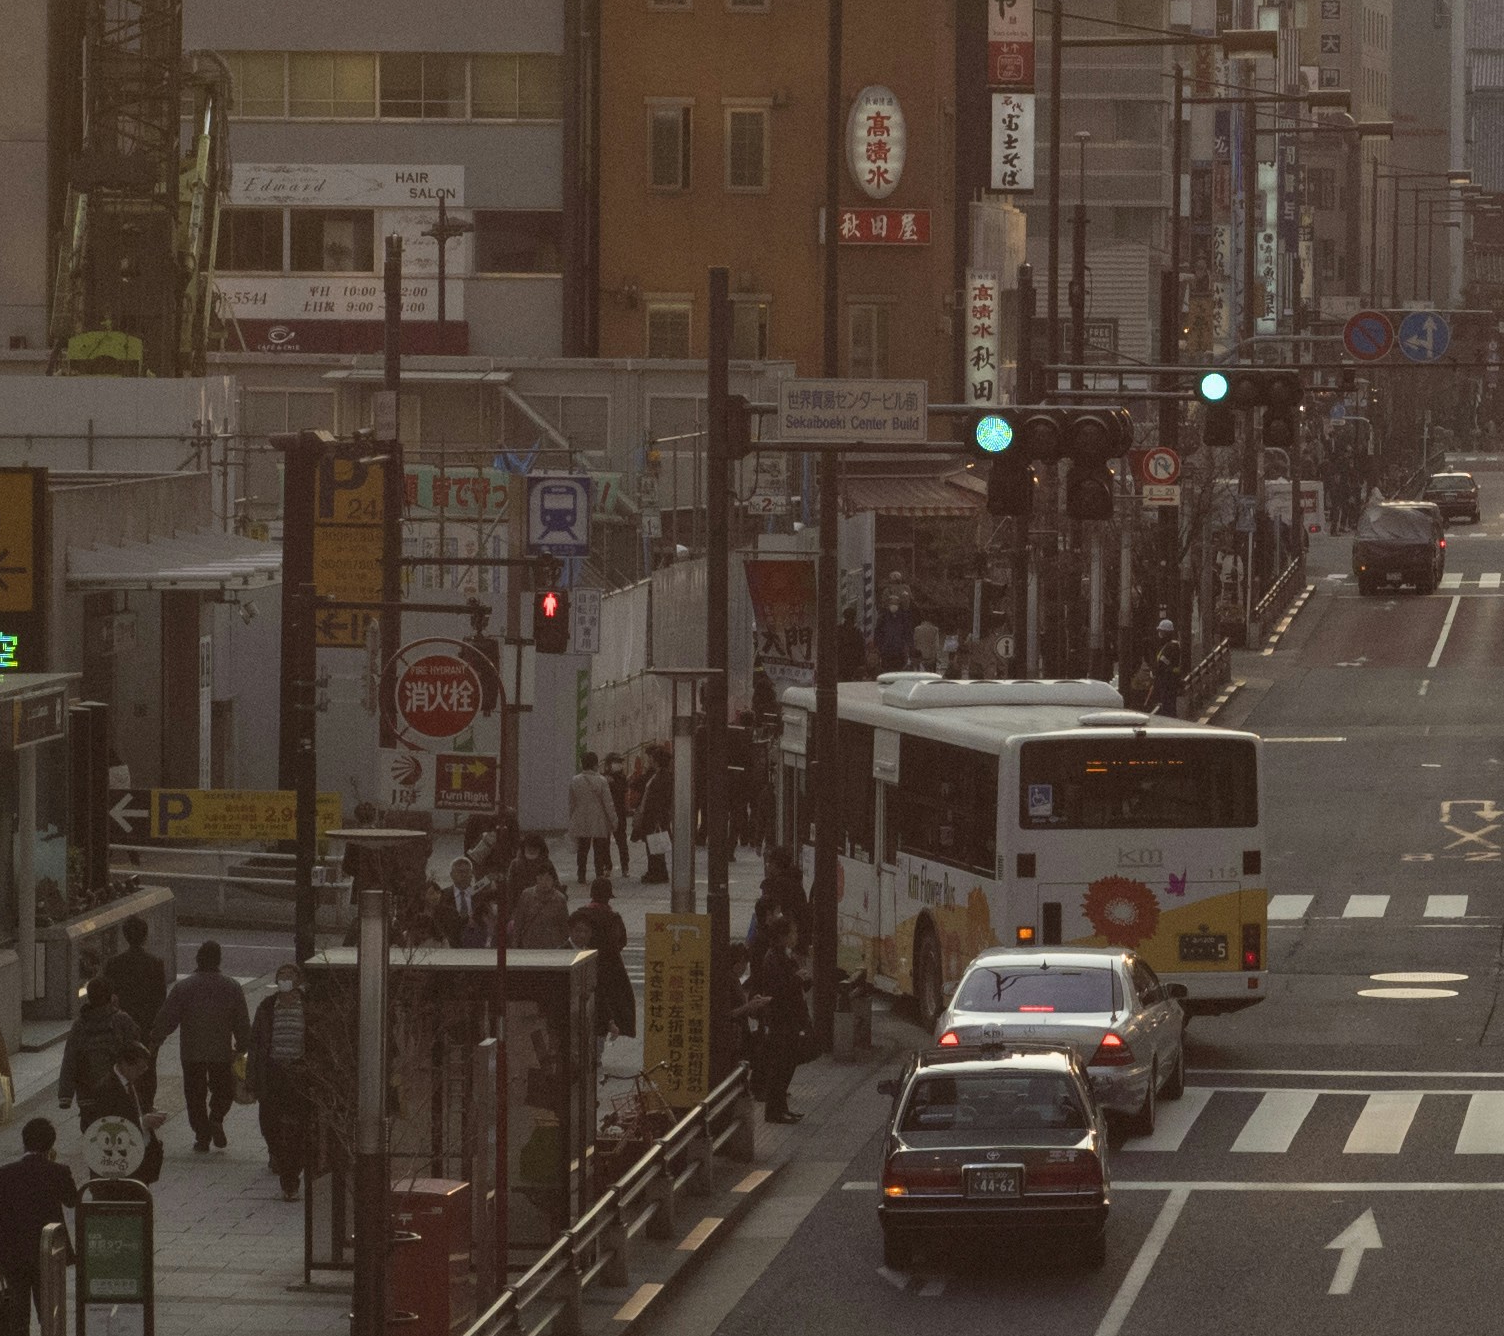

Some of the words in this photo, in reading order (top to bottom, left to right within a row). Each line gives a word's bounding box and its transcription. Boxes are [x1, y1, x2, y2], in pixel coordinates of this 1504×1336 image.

[394, 171, 431, 184] HAIR
[407, 187, 456, 200] SALON
[839, 212, 919, 241] 秋田屋
[399, 286, 428, 297] 2:00
[787, 389, 918, 411] 世界貿易センタービル前
[786, 414, 846, 430] Sekaiboeki
[851, 414, 887, 430] Center
[892, 414, 919, 430] Build
[319, 460, 367, 520] P
[410, 665, 430, 675] FIRE
[431, 665, 466, 675] HYDRANT
[403, 679, 475, 713] 消火栓
[440, 789, 464, 802] Turn
[465, 790, 490, 804] Right
[157, 793, 193, 836] P
[1117, 847, 1164, 864] km
